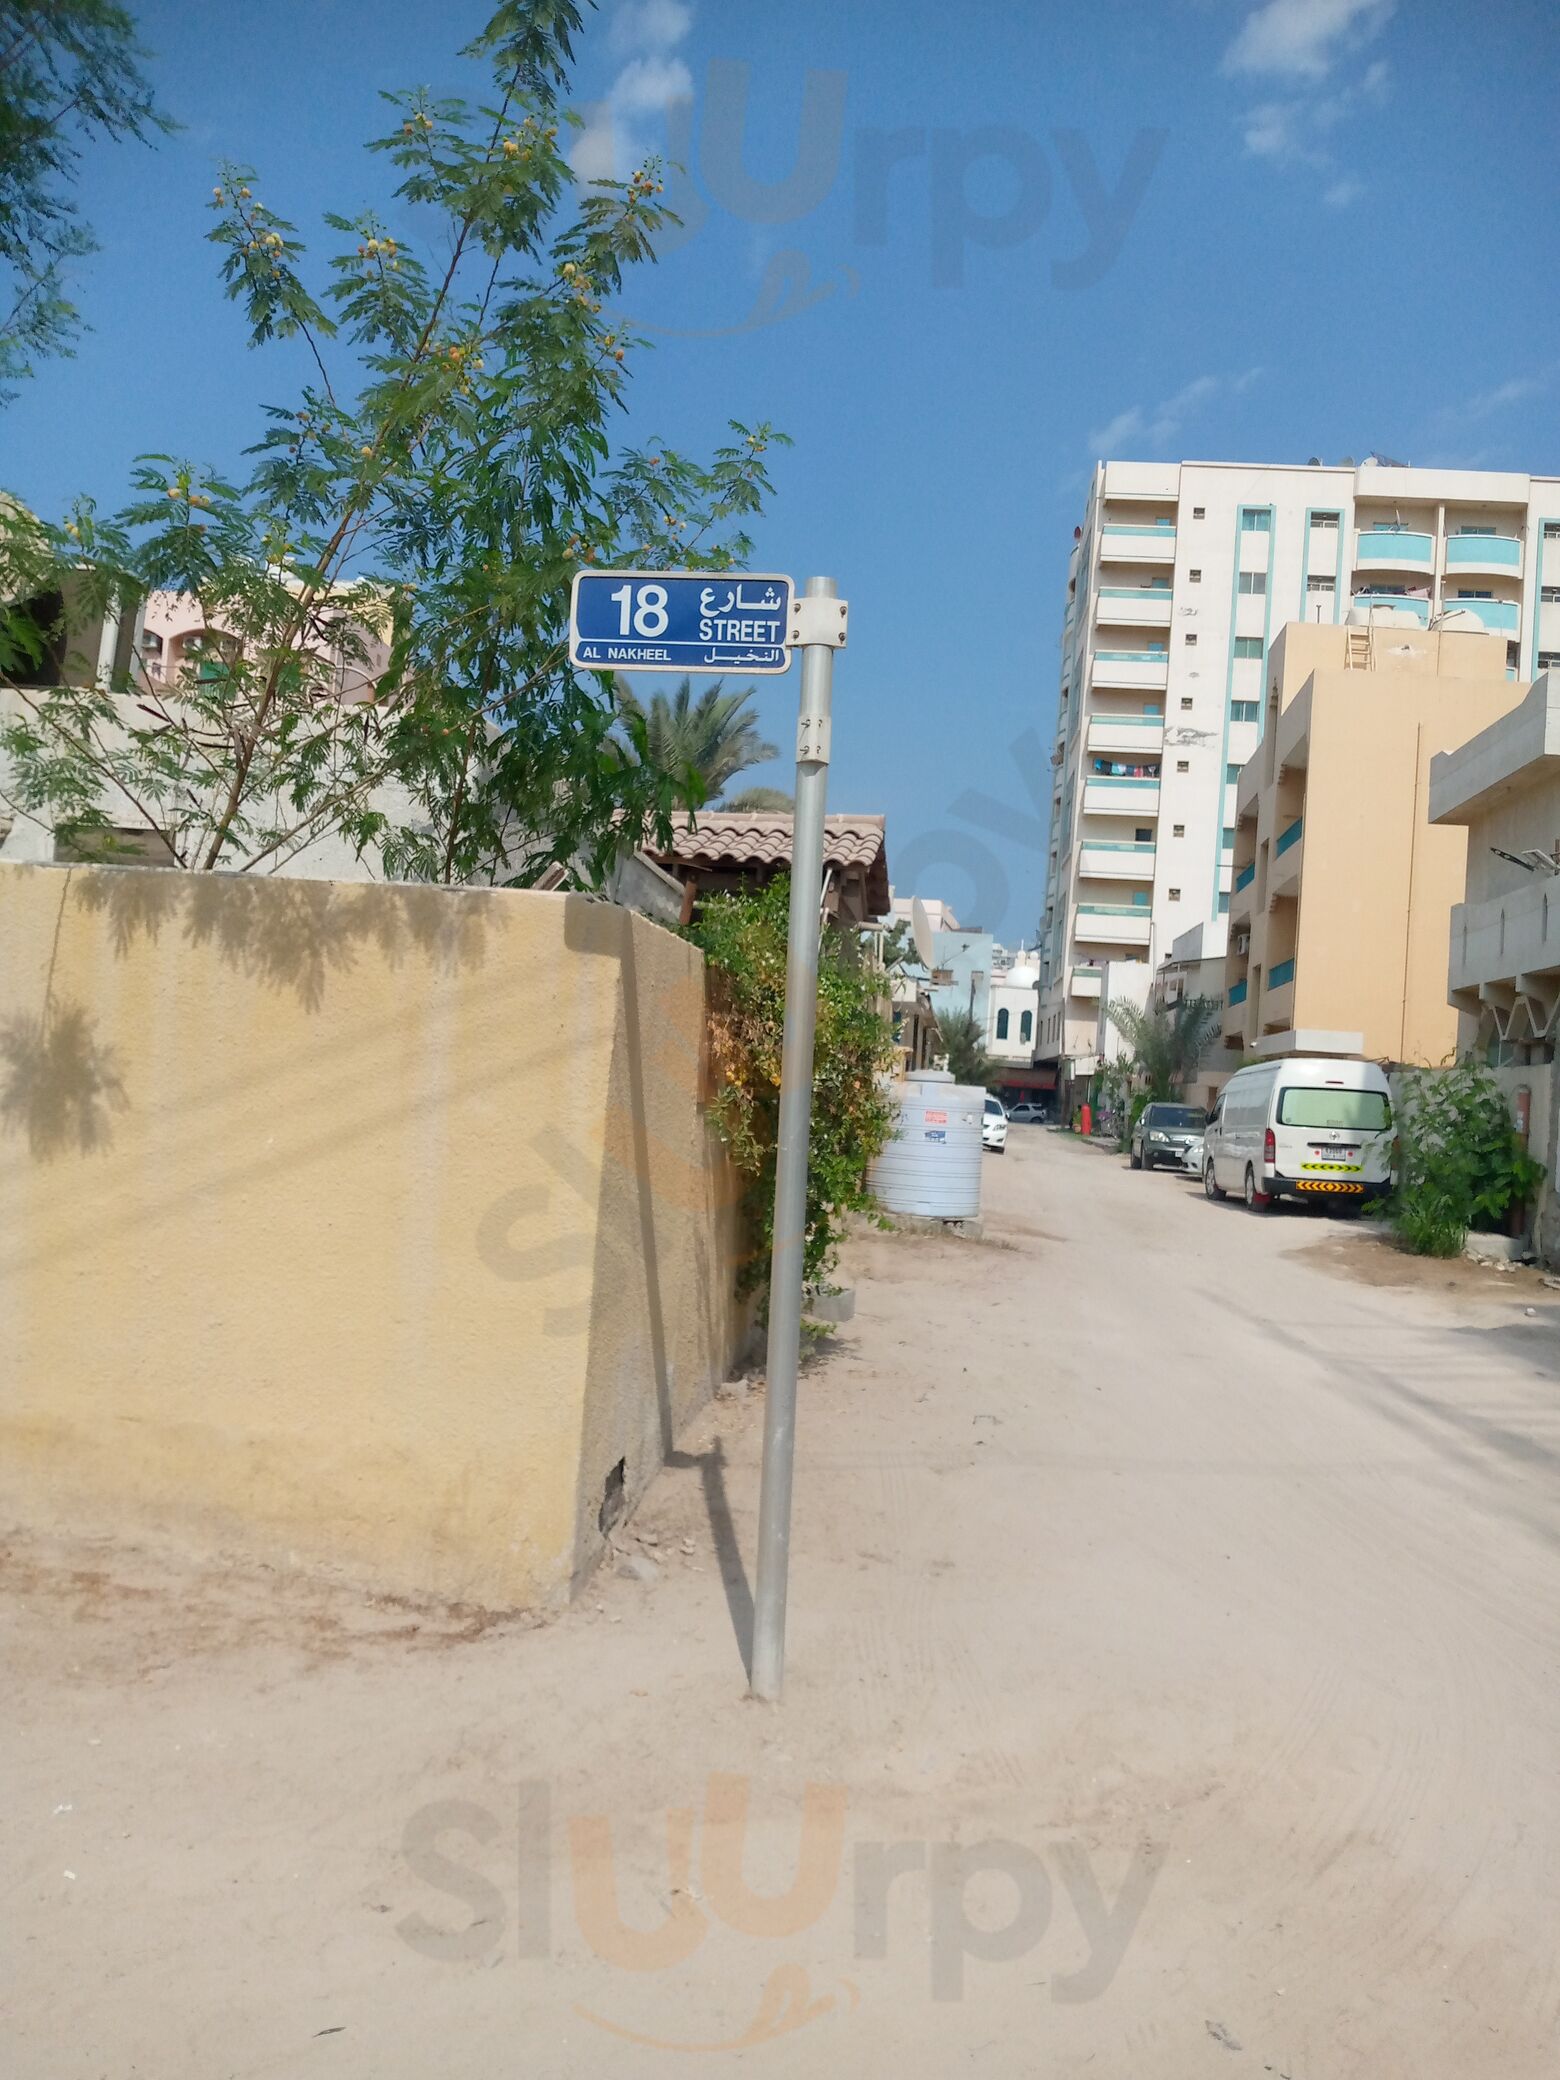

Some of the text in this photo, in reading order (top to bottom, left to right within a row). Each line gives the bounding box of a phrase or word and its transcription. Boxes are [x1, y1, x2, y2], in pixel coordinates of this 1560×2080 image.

[611, 584, 669, 637] 18
[700, 583, 781, 617] شارع
[699, 618, 781, 642] STREET
[583, 648, 671, 661] AL NAKHEEL
[704, 647, 779, 663] النخيل
